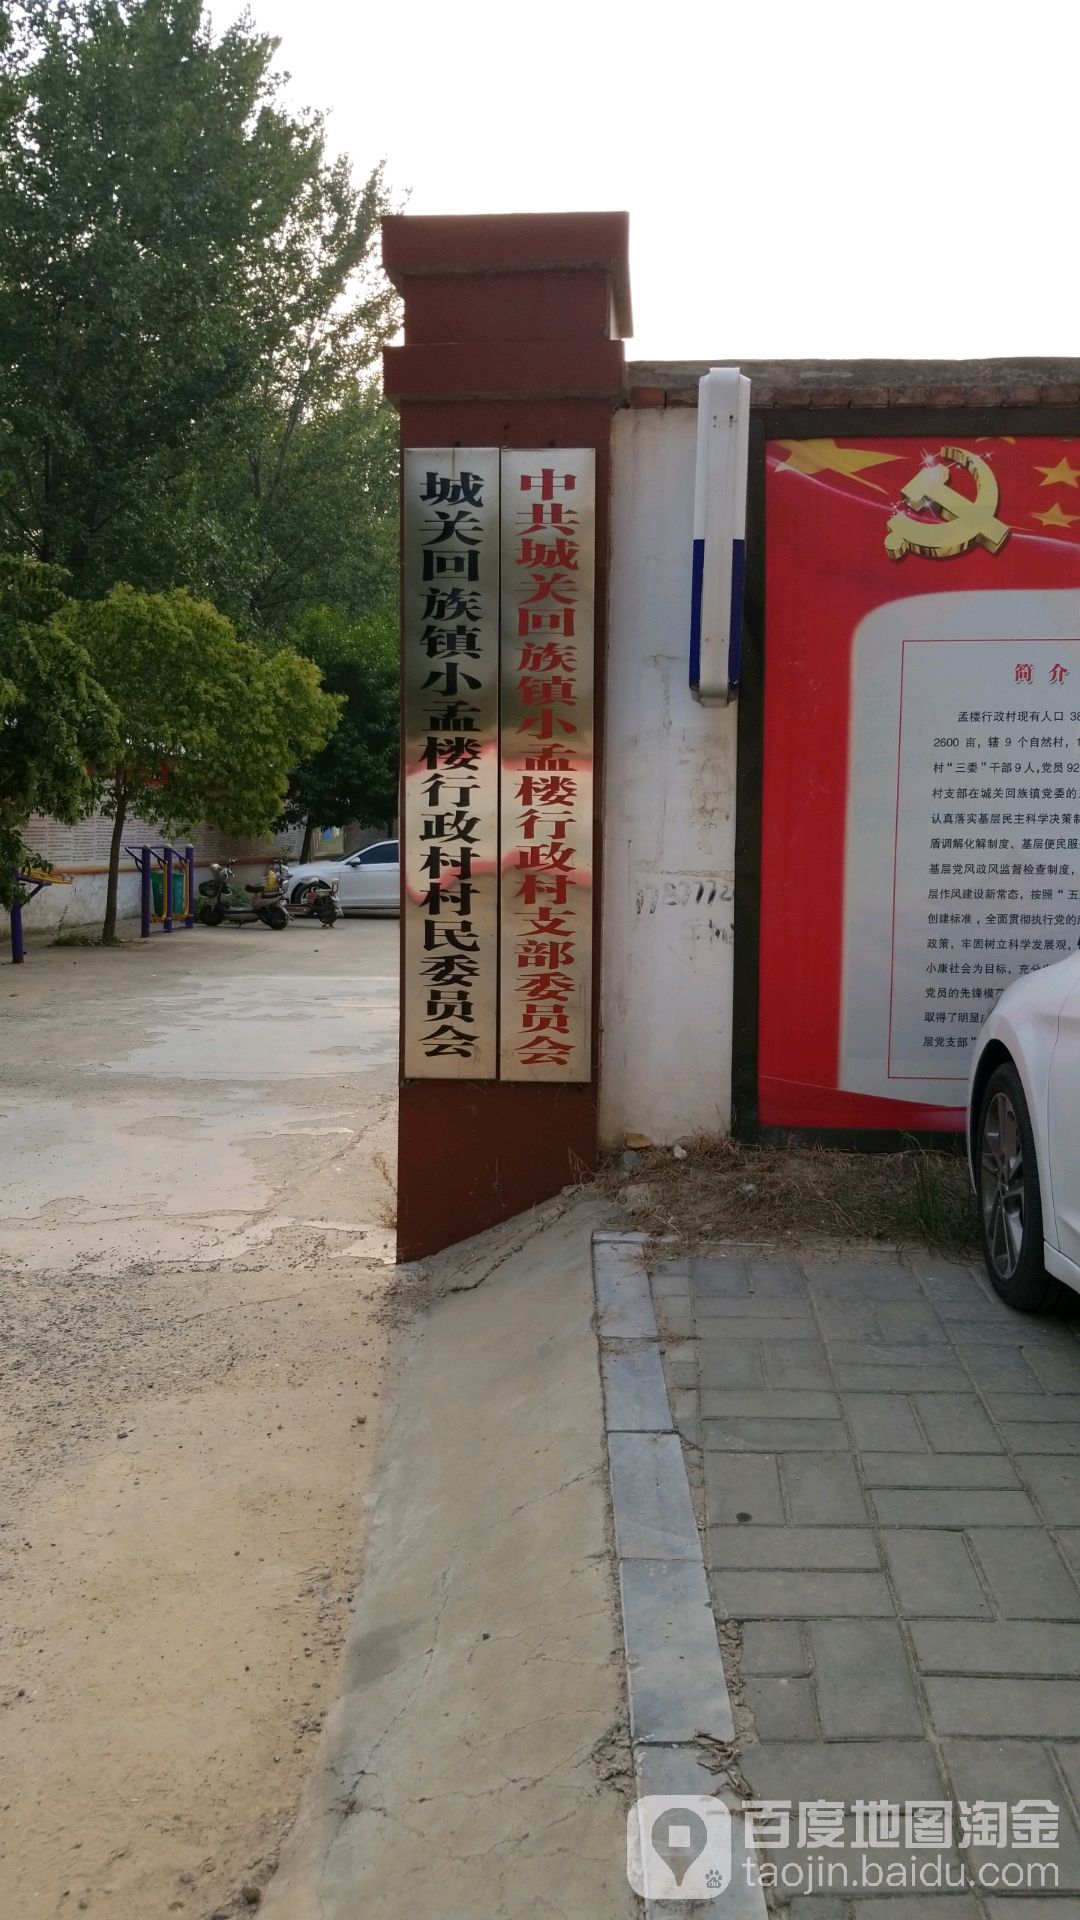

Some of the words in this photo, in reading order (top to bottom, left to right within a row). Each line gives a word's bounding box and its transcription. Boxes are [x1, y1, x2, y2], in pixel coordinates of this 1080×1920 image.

[1014, 663, 1070, 684] 简介
[419, 471, 484, 1058] 城关回族镇小孟楼行政村村民委员会
[514, 468, 580, 1066] 中共城关回族镇小孟楼行政村支部委员会
[931, 787, 1080, 799] 村支部在城关回族镇党委的
[929, 838, 1080, 850] 盾调解化解制度、基层便民服
[927, 913, 1080, 926] 创建标准，全面贯彻执行党的
[926, 938, 1080, 951] 政策，牢固树立科学发展观，
